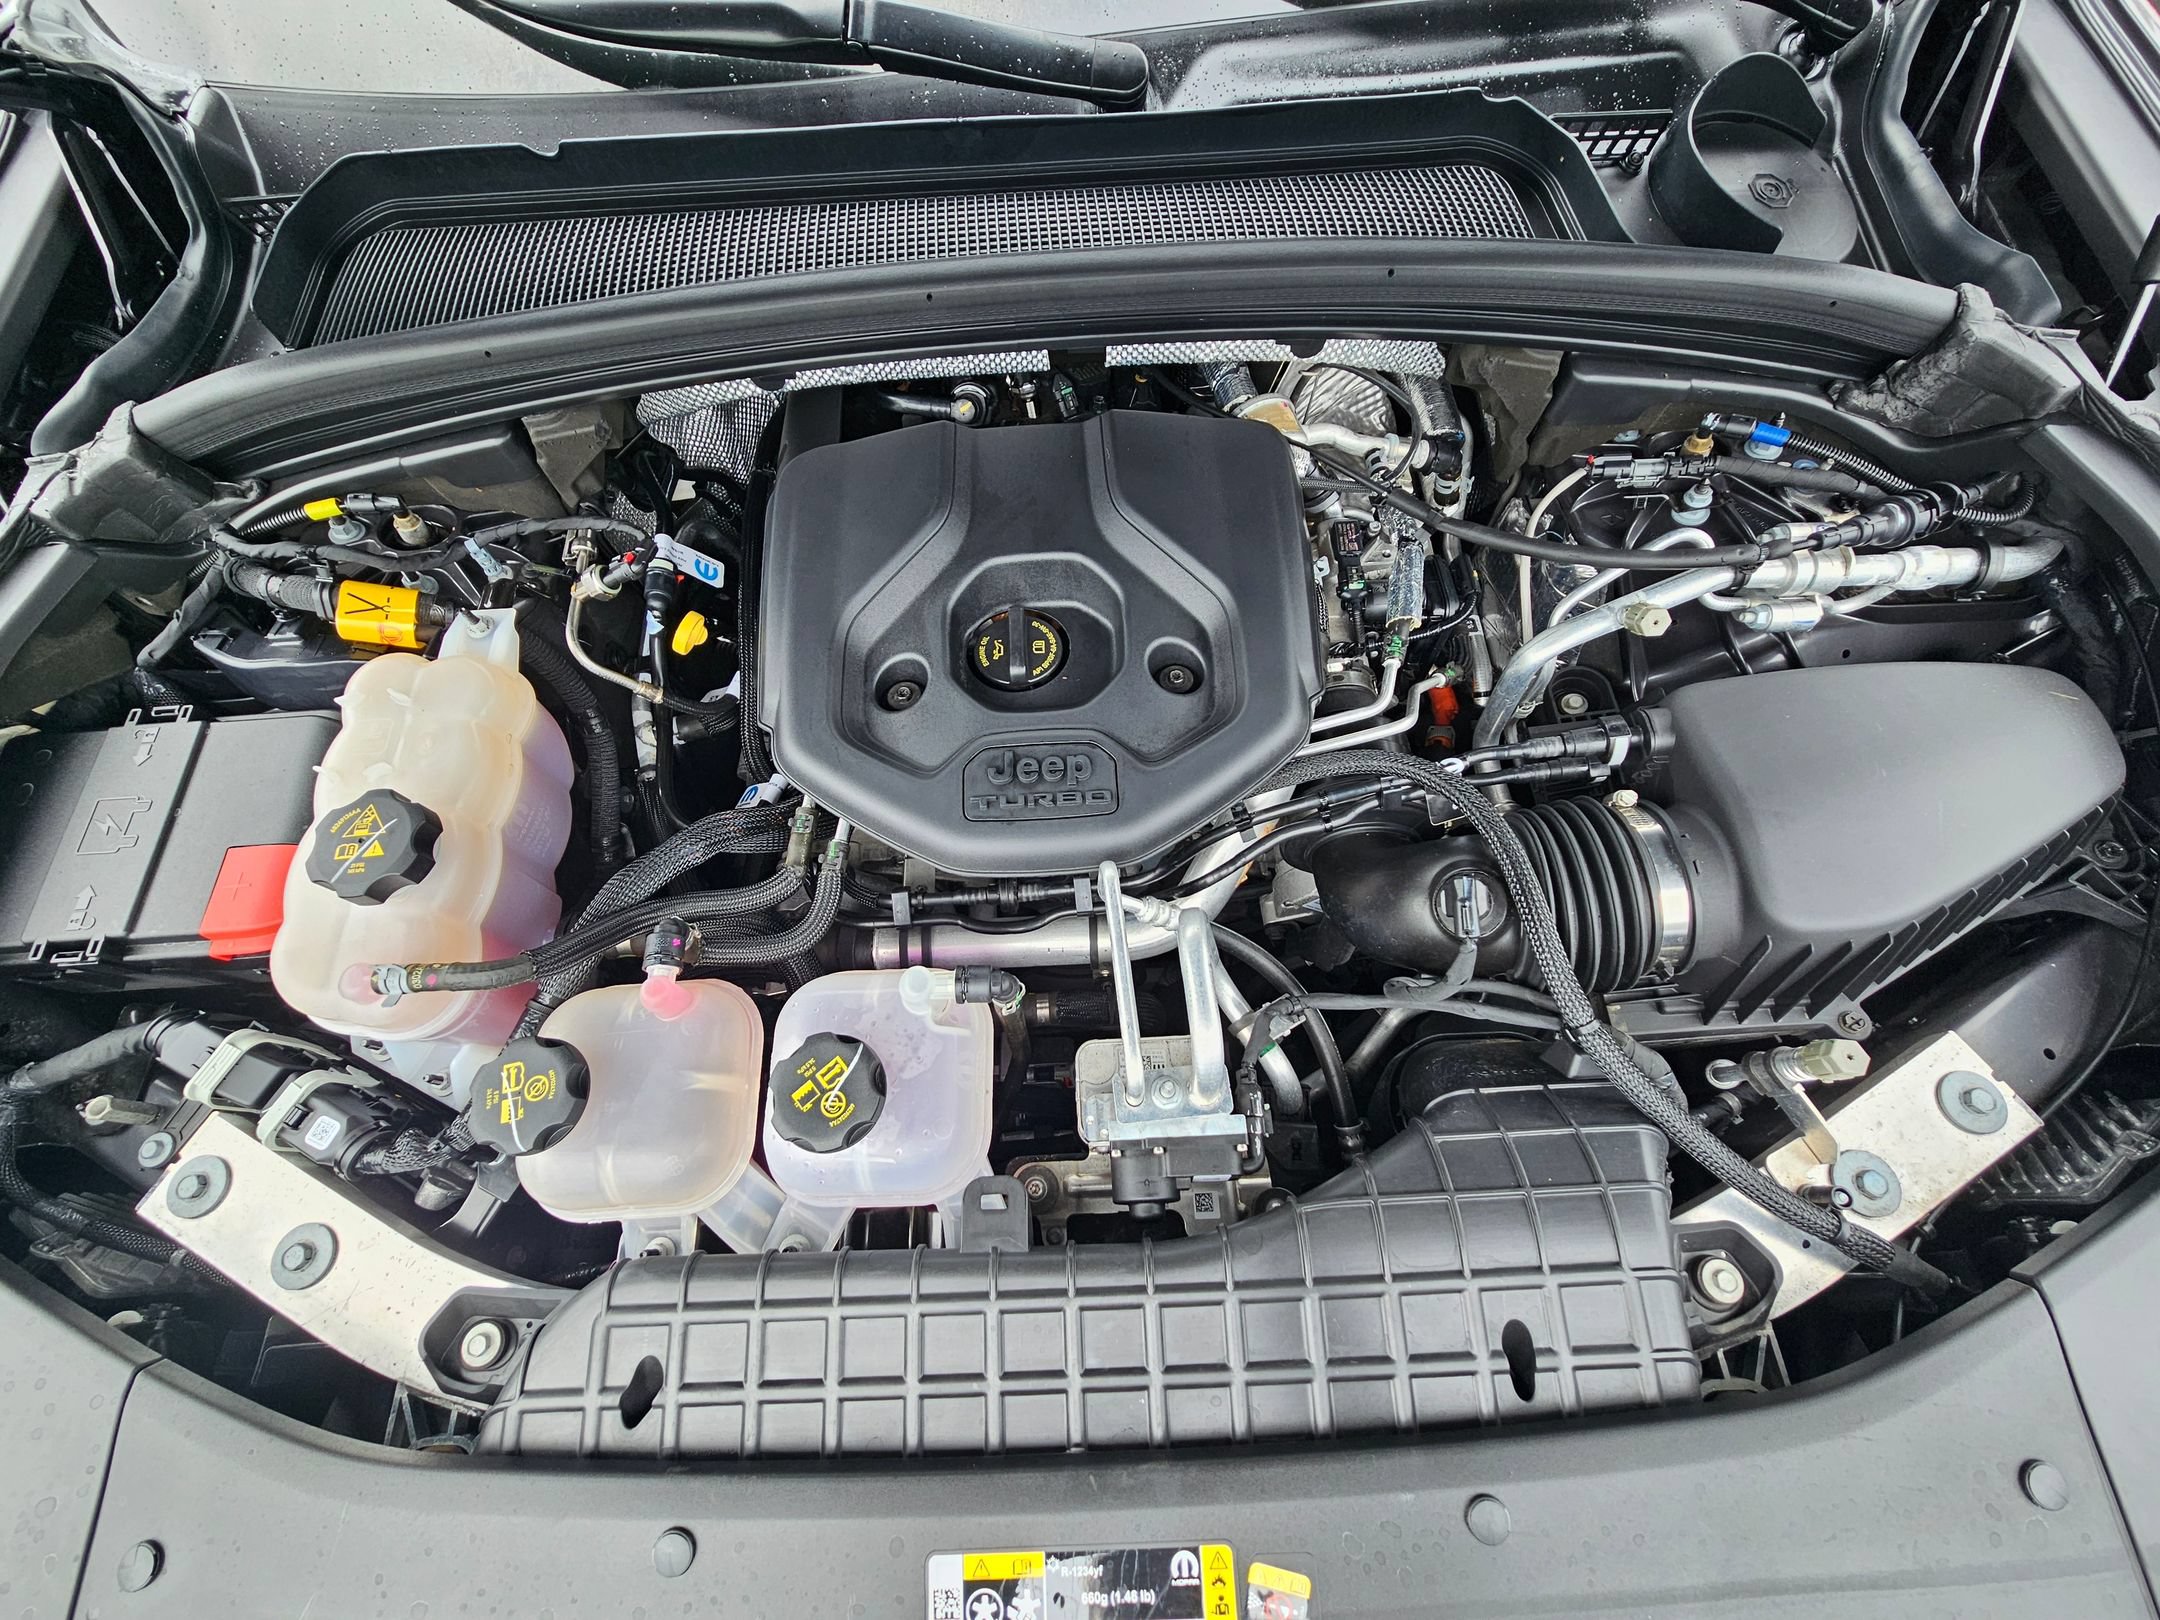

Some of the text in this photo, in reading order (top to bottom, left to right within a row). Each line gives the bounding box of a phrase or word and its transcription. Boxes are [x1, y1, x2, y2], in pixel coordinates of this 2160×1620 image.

[979, 636, 990, 667] ENGINE OIL
[987, 749, 1093, 788] Jeep
[969, 788, 1113, 811] TURBO
[1061, 1564, 1104, 1579] R-1234yf
[1081, 1591, 1109, 1607] 660g
[1139, 1588, 1156, 1606] lb)
